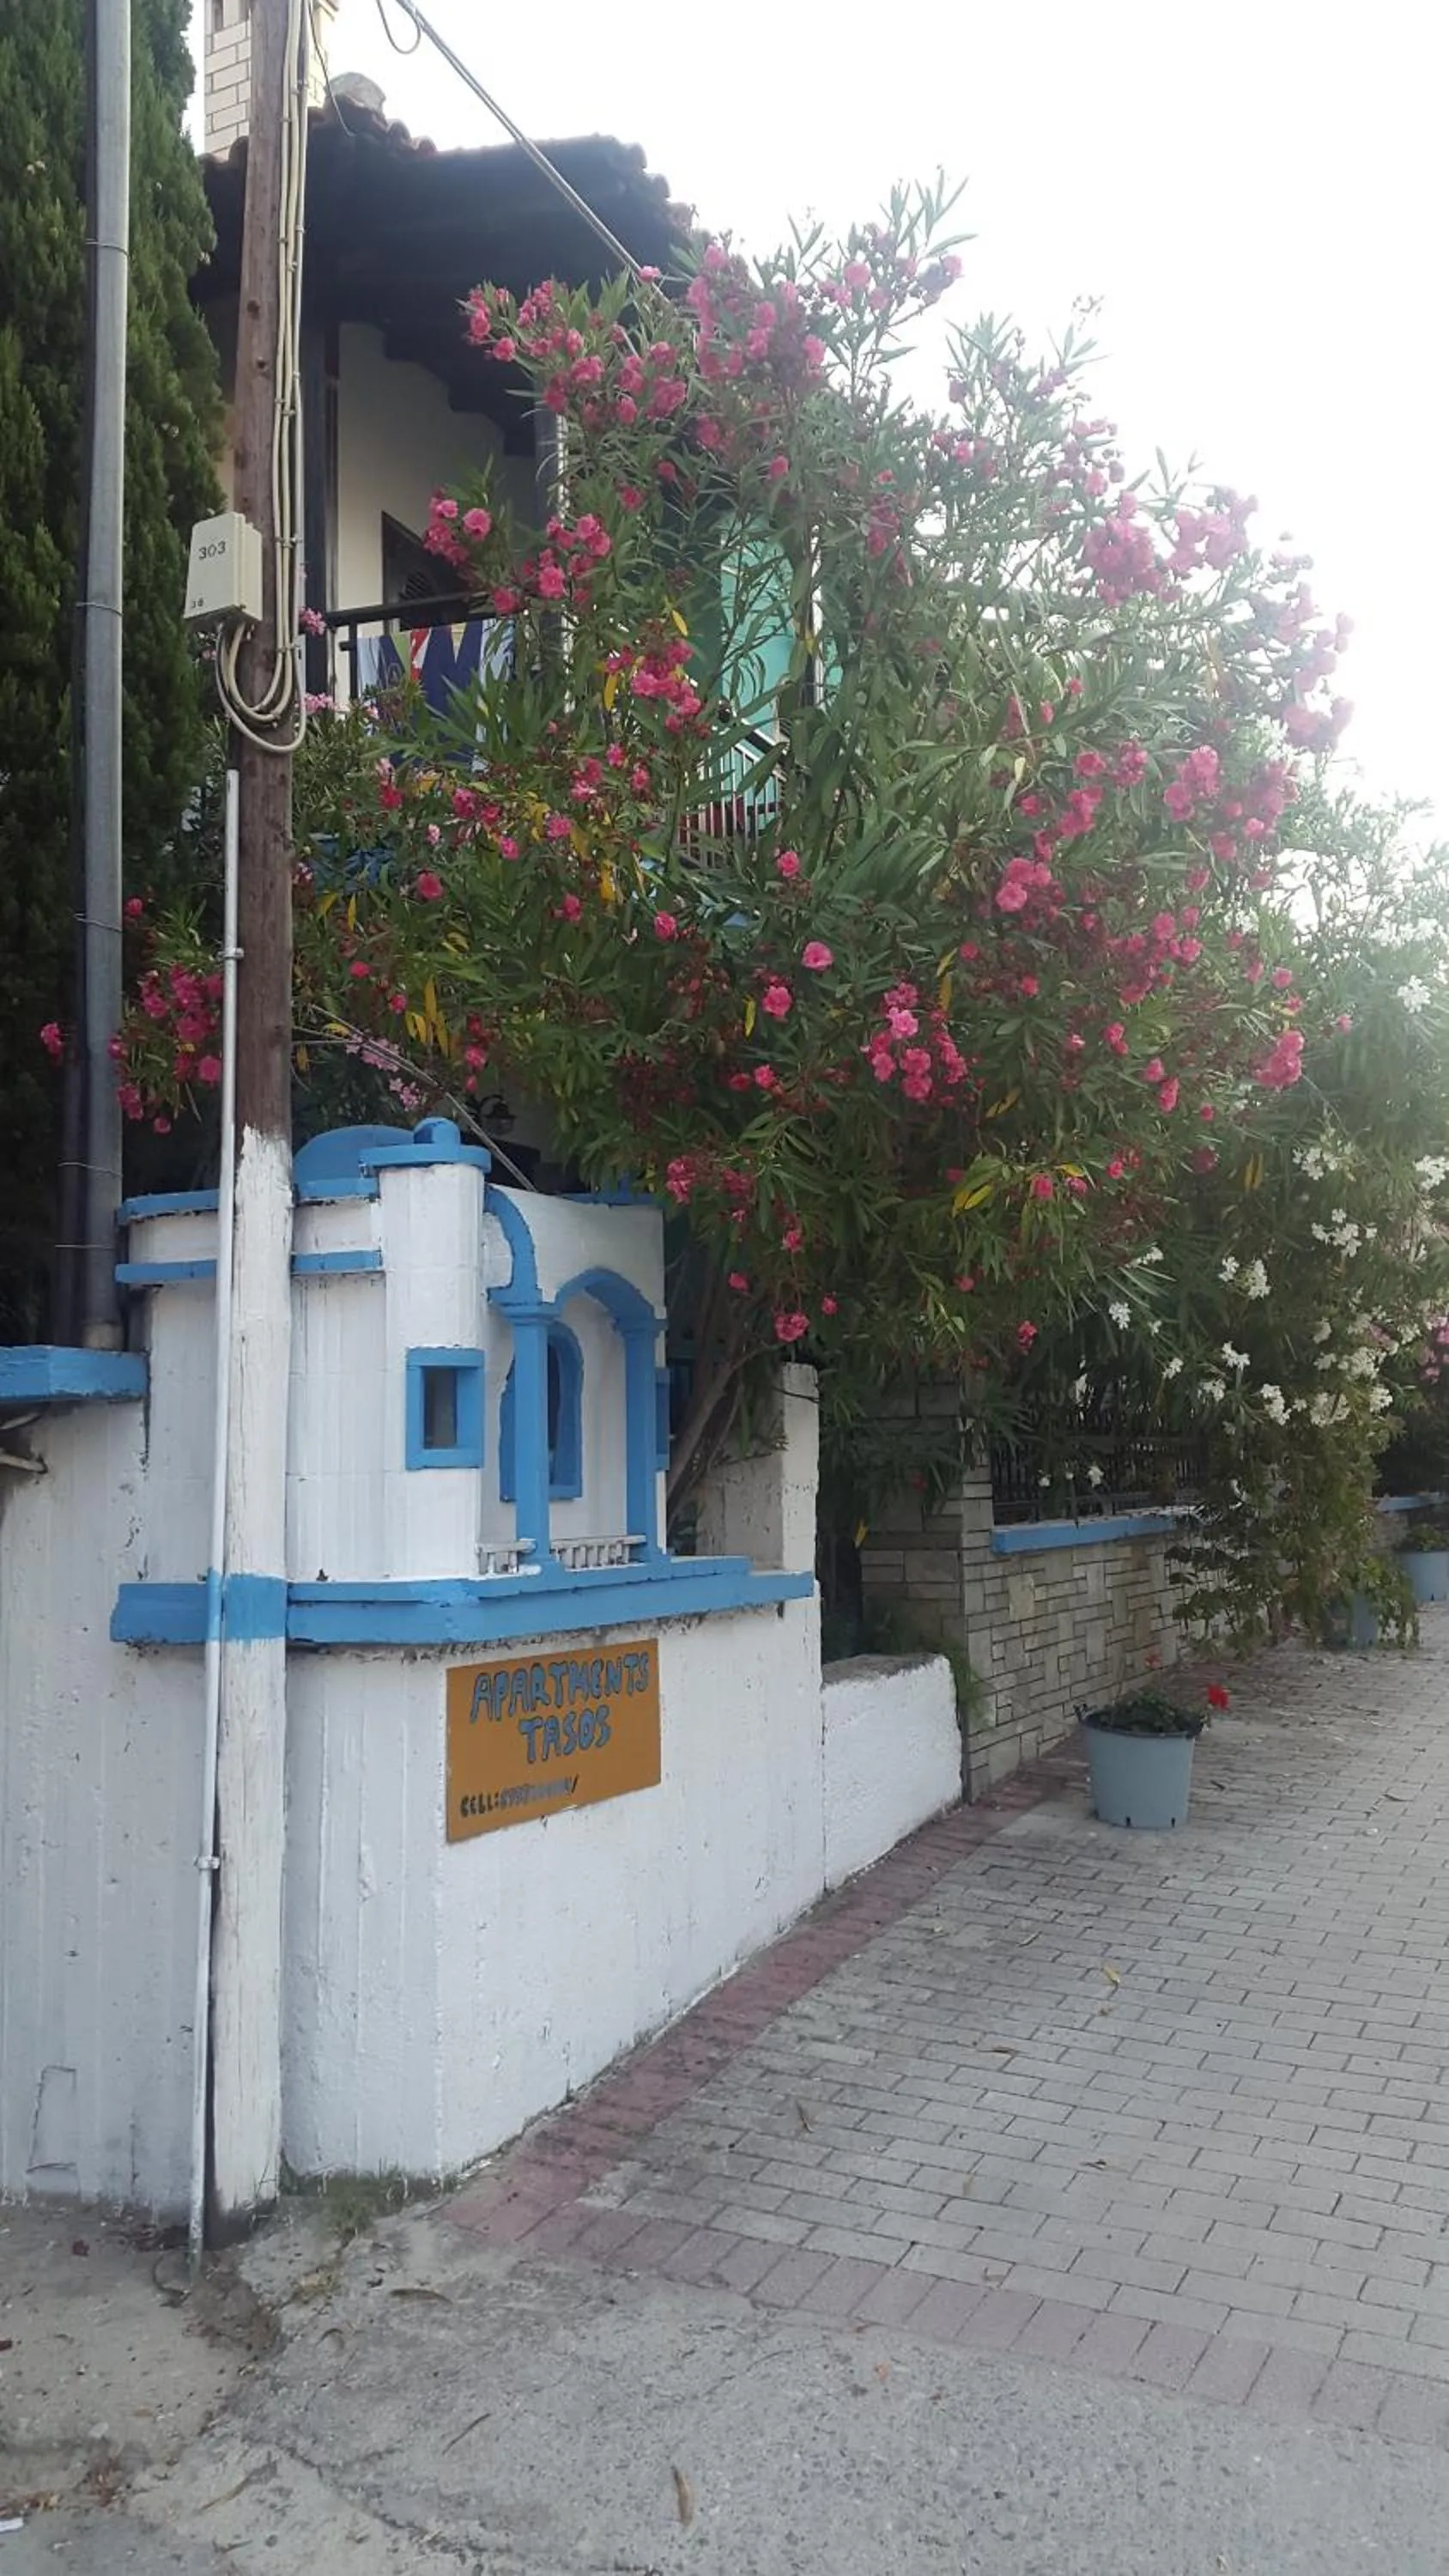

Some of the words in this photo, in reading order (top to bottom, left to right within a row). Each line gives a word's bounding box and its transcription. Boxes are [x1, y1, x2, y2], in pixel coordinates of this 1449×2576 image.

[198, 540, 226, 562] 303
[470, 1651, 650, 1724] APARTMENTS
[518, 1704, 612, 1764] TASOS
